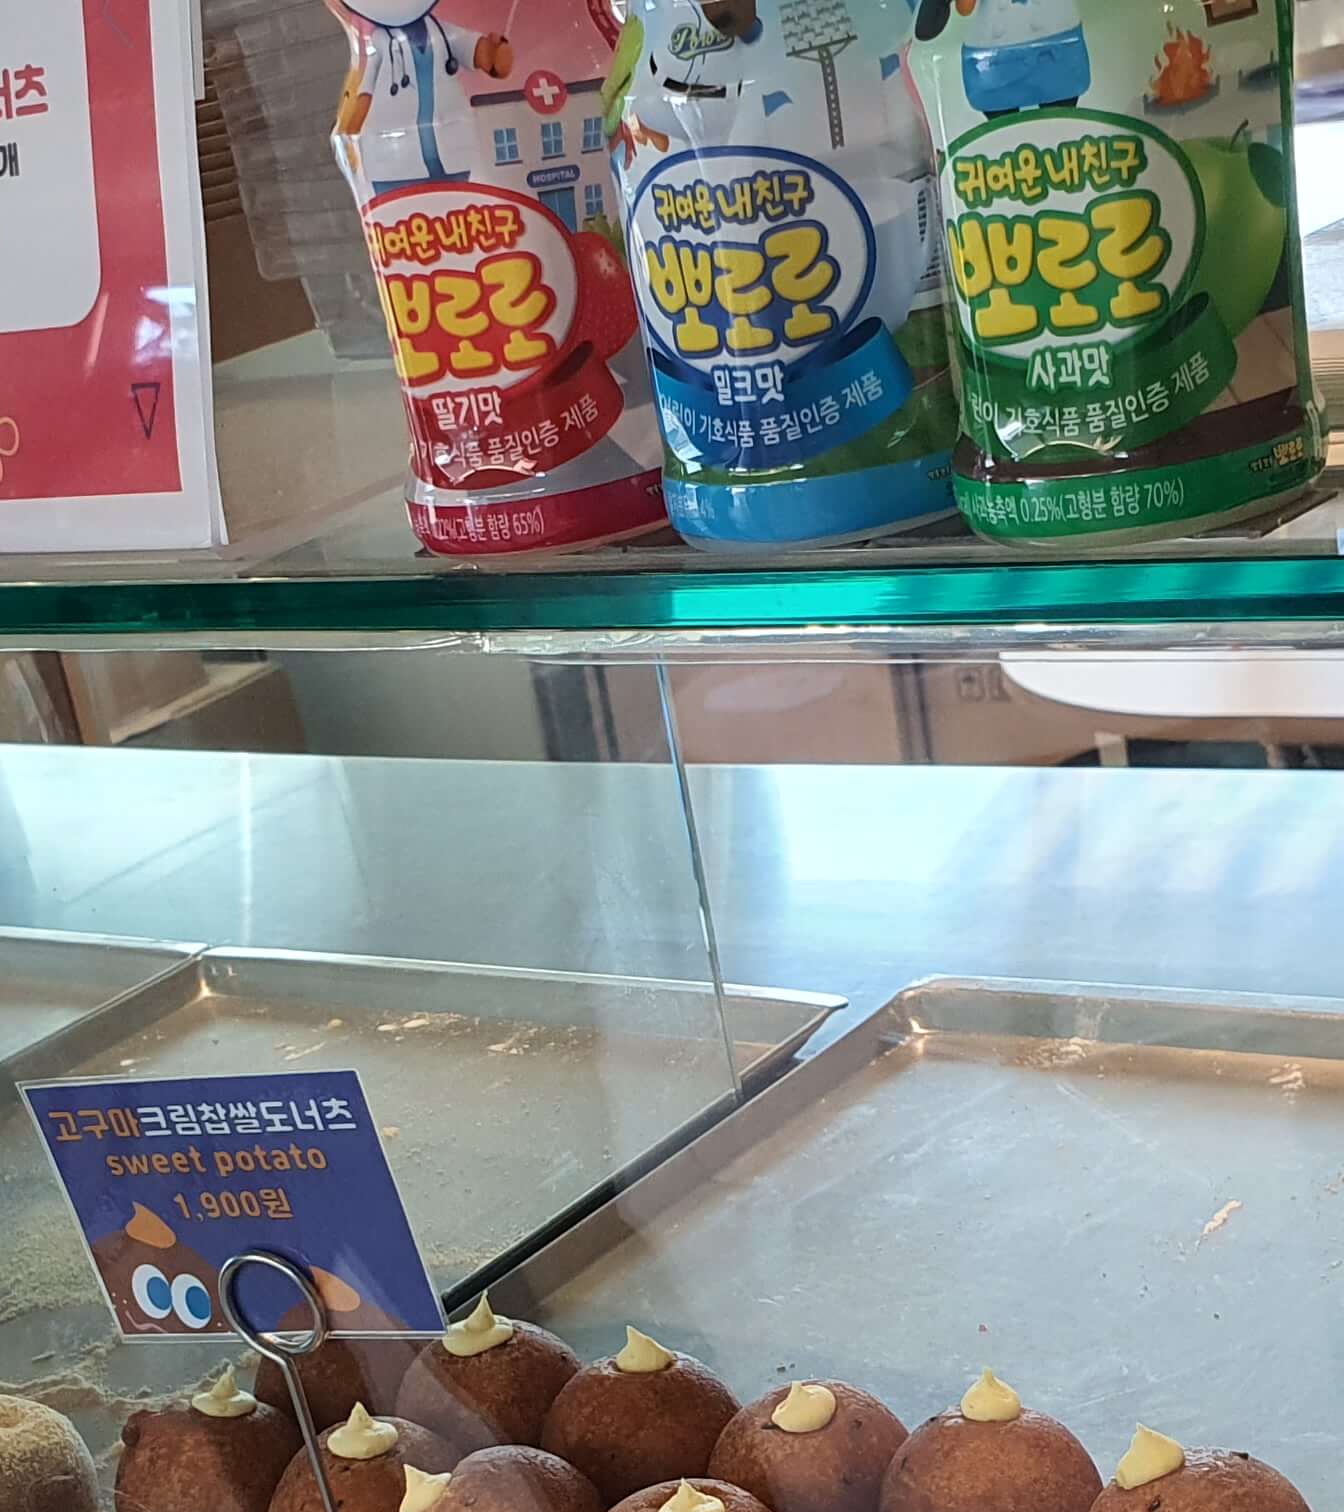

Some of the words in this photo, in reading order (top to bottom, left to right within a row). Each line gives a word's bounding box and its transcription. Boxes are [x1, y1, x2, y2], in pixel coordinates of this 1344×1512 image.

[531, 168, 576, 184] HOSPITAL
[955, 147, 1043, 202] 귀여운
[653, 181, 716, 231] 귀여운
[645, 226, 834, 352] 뽀로로
[947, 197, 1165, 337] 뽀로로
[712, 365, 785, 406] 밀크맛
[1031, 345, 1111, 389] 사과맛
[431, 391, 504, 431] 딸기맛
[698, 413, 755, 449] 기호식품
[759, 395, 841, 446] 품질인증
[841, 370, 885, 410] 제품
[1005, 405, 1081, 437] 기호식품
[1085, 381, 1169, 434] 품질인증
[1171, 351, 1210, 393] 제품
[487, 419, 560, 464] 품질인증
[560, 394, 599, 432] 제품
[1109, 483, 1141, 517] 함량
[1142, 477, 1186, 512] 70%)
[512, 504, 545, 536] 65%)
[48, 1096, 358, 1143] 고구마크림찹쌀도너츠
[105, 1145, 207, 1176] sweet
[213, 1143, 329, 1177] potato
[172, 1186, 295, 1223] 1,900원
